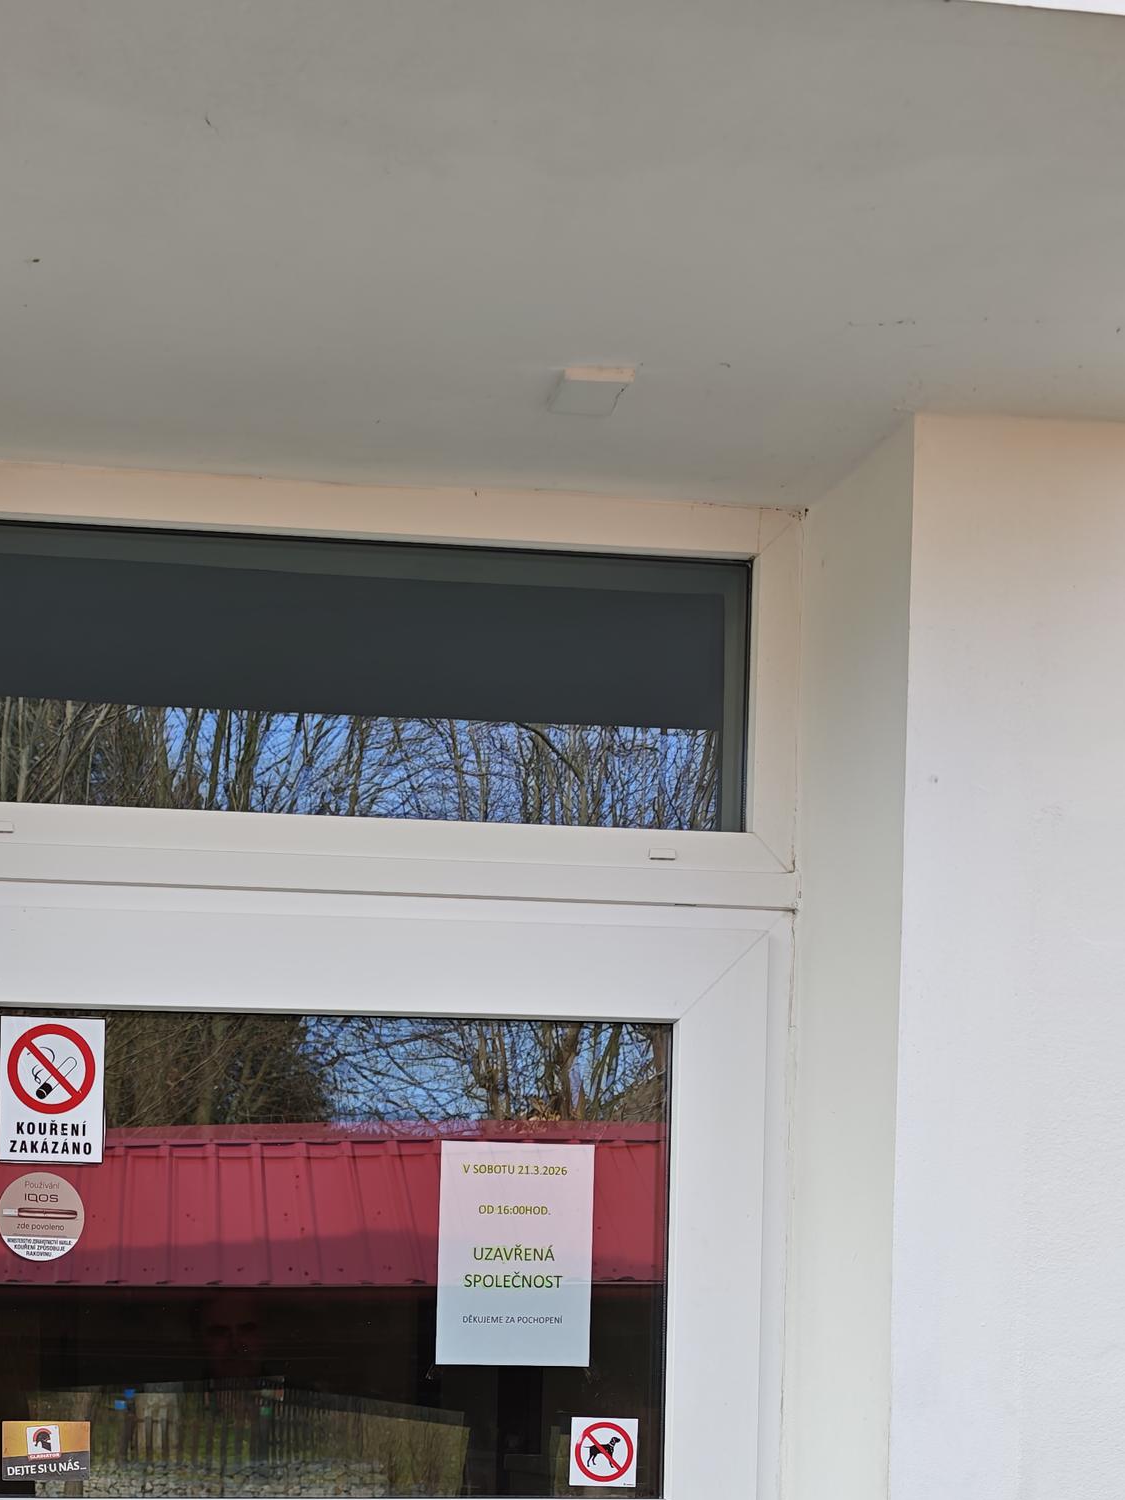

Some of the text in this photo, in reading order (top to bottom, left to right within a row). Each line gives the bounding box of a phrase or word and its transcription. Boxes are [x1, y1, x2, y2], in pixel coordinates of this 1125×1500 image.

[15, 1120, 87, 1137] KOUŘENÍ
[9, 1138, 92, 1155] ZAKÁZÁNO
[463, 1164, 568, 1176] V SOBOTU 21.3.2026
[24, 1193, 59, 1203] IQOS
[478, 1205, 552, 1216] OD 16:00HOD.
[17, 1222, 65, 1231] zde povoleno
[473, 1244, 556, 1262] UZAVŘENÁ
[464, 1271, 564, 1289] SPOLEČNOST
[462, 1314, 563, 1325] DĚKUJEME ZA POCHOPENÍ
[6, 1465, 37, 1476] DEJTE
[37, 1464, 48, 1474] SI
[49, 1463, 57, 1473] U
